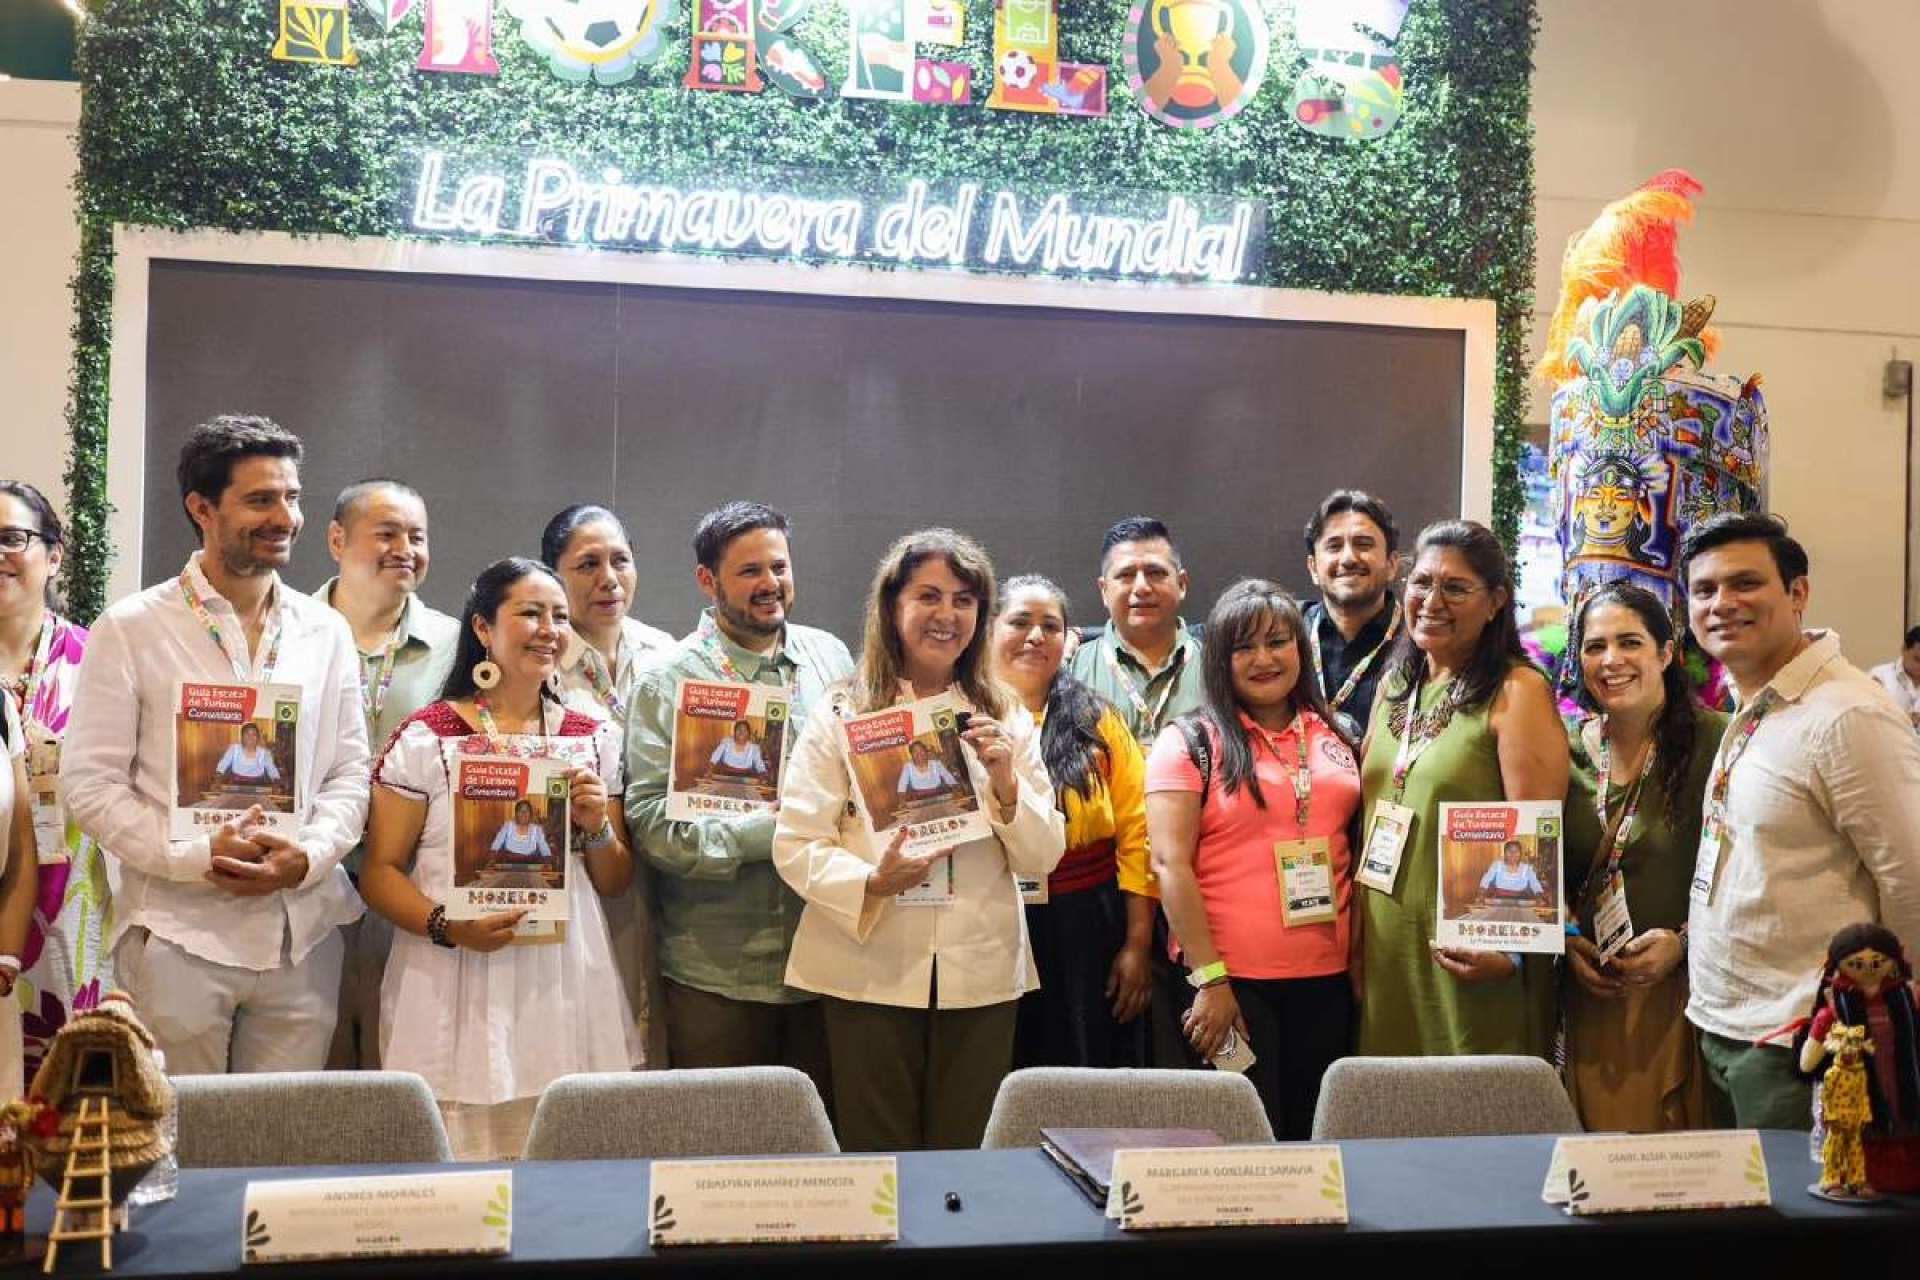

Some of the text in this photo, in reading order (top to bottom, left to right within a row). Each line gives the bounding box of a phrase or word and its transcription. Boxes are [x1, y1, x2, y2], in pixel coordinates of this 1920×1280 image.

[412, 152, 1253, 281] La Primavera del Mundial
[465, 774, 516, 786] de Turismo
[194, 811, 277, 826] MOROS
[891, 818, 969, 838] ORELOS
[1453, 829, 1505, 840] Comunitario
[469, 890, 549, 904] MORELOS
[1459, 922, 1541, 937] MORELOS
